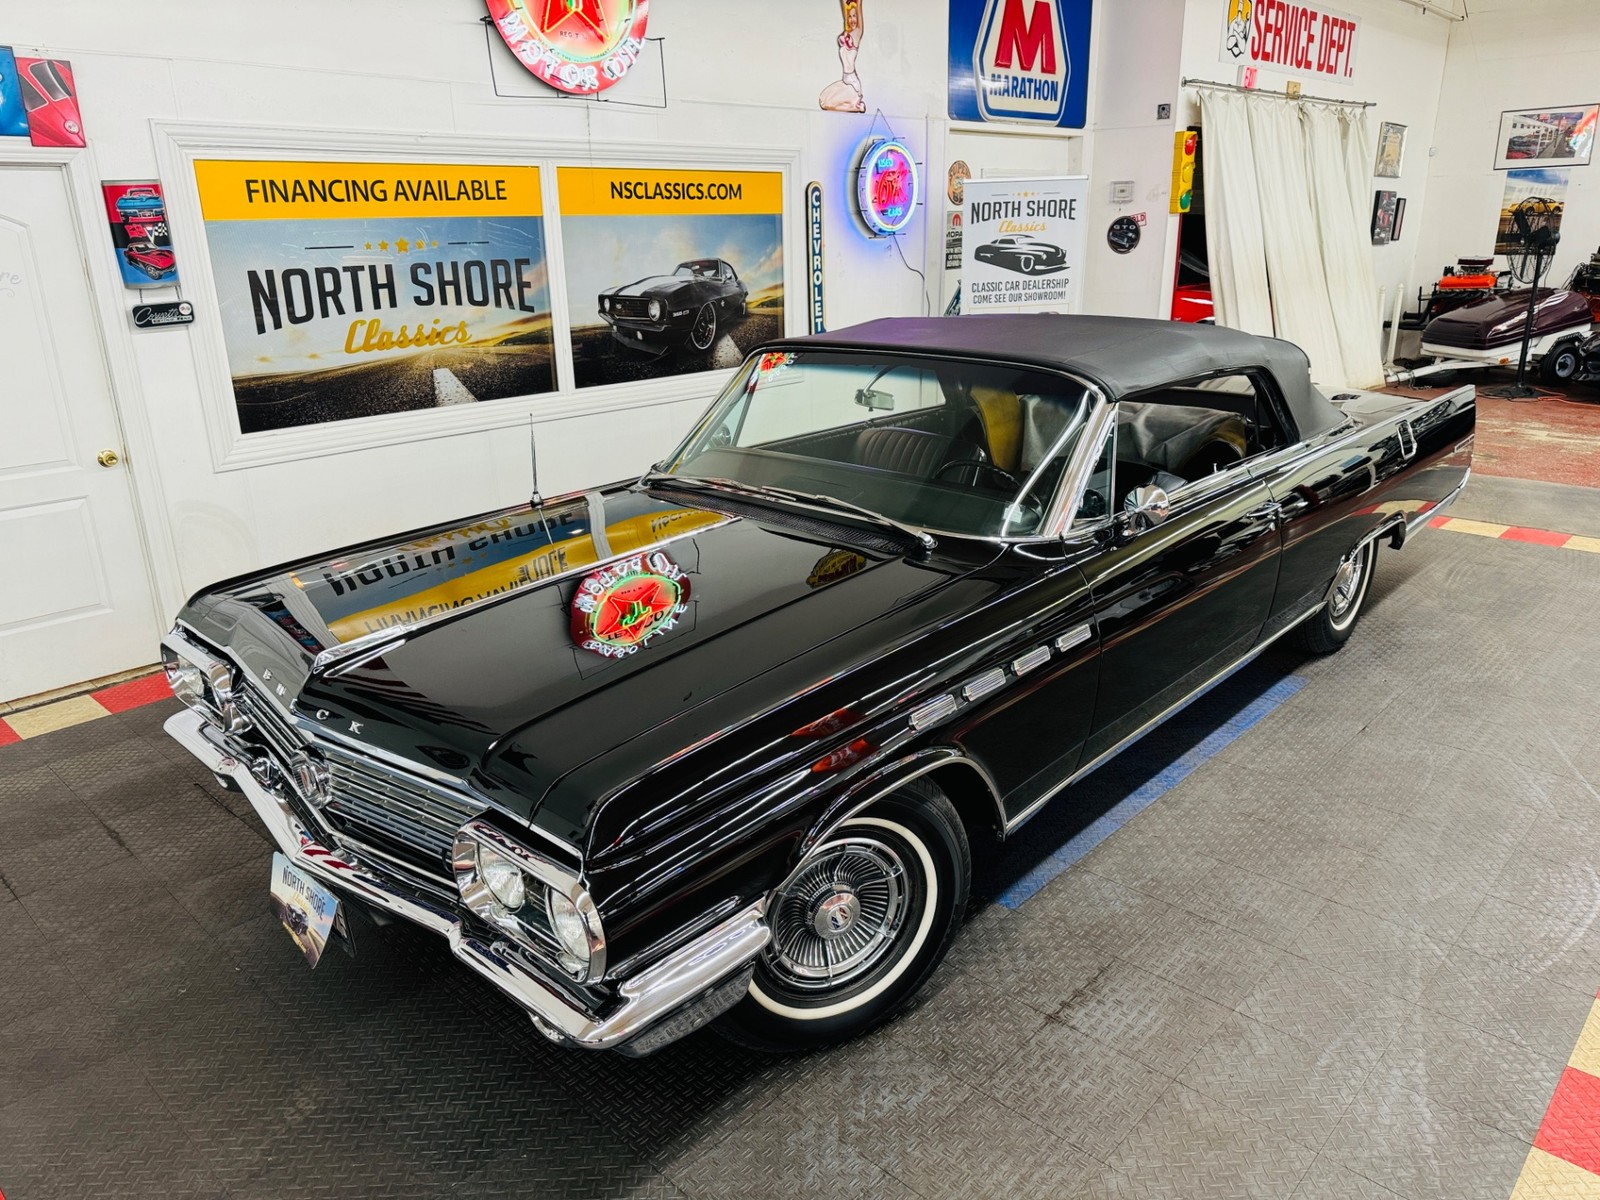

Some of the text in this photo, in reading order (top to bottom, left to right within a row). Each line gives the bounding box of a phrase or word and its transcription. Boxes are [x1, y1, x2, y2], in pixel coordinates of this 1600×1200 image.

[499, 10, 646, 91] MOTOR OIL
[1251, 0, 1356, 78] SERVICE DEPT.
[989, 73, 1058, 102] MARATHON
[245, 179, 508, 204] FINANCING AVAILABLE
[610, 181, 742, 201] NSCLASSICS.COM
[971, 198, 1077, 225] NORTH SHORE
[998, 219, 1047, 234] Classics
[811, 190, 824, 335] CHEVROLET
[247, 257, 536, 335] NORTH SHORE
[971, 277, 1070, 294] CLASSIC CAR DEALERSHIP
[972, 290, 1066, 305] COME SEE OUR SHOWROOM!
[134, 306, 181, 325] Corvette
[343, 317, 473, 356] Classics
[282, 865, 306, 896] NORTH
[305, 886, 326, 921] SHORE
